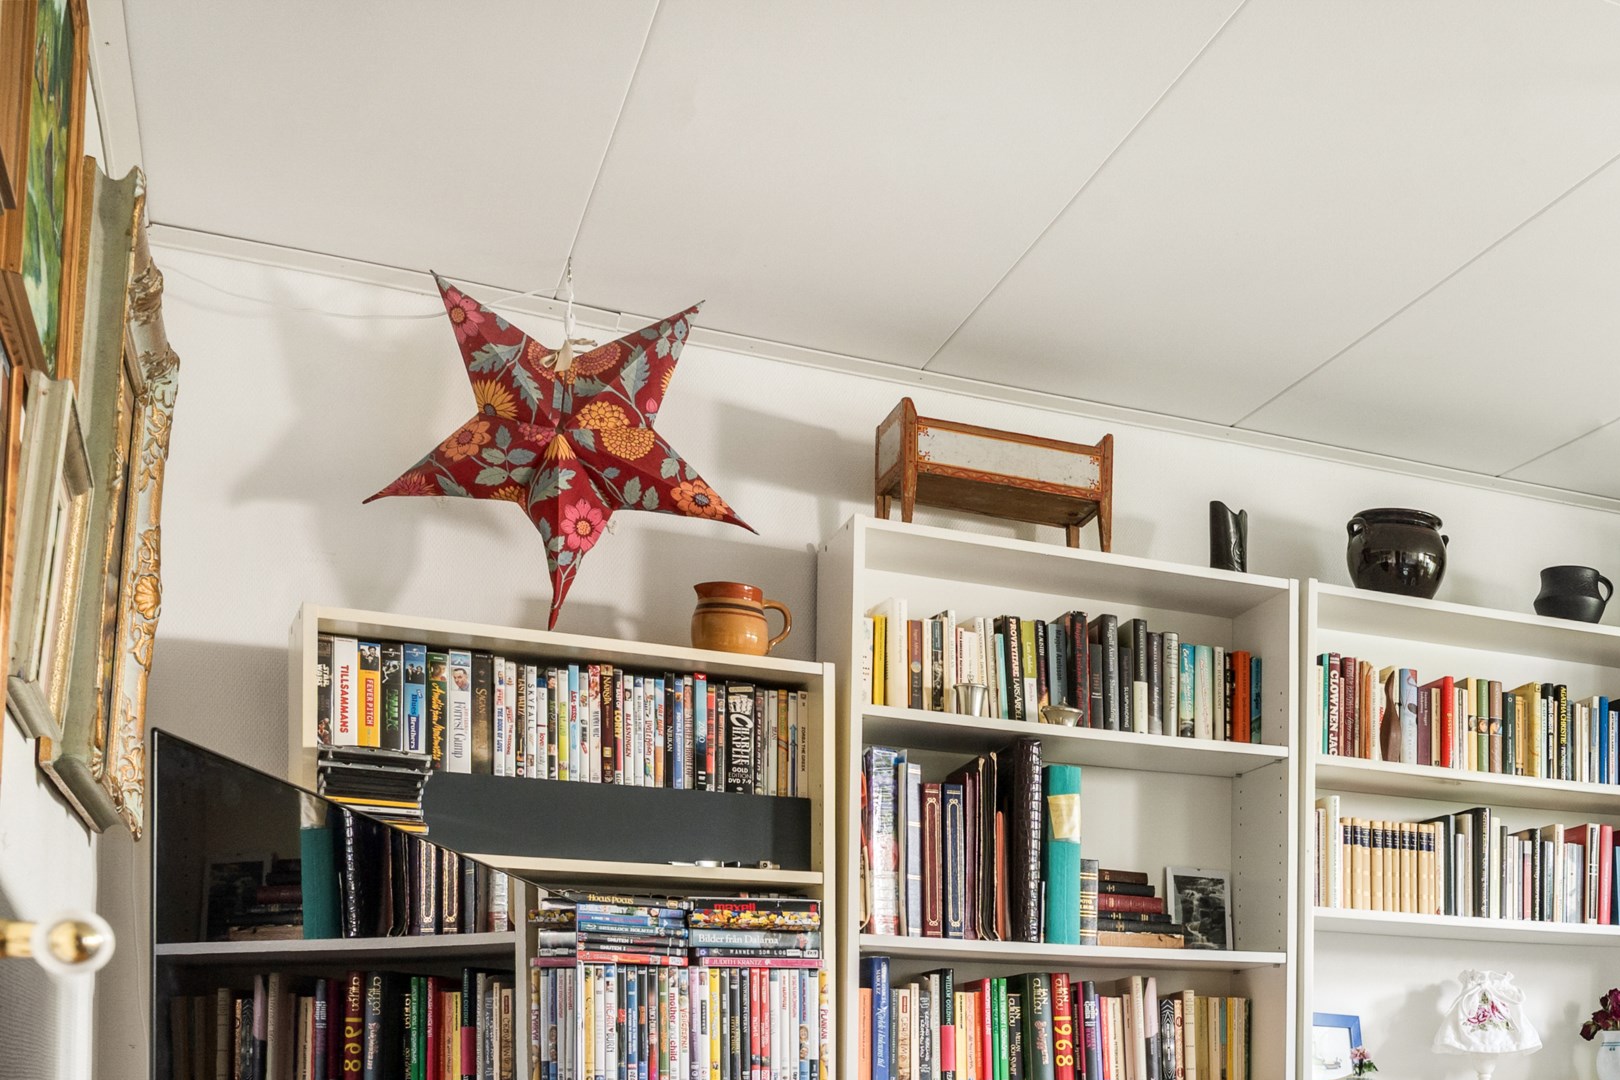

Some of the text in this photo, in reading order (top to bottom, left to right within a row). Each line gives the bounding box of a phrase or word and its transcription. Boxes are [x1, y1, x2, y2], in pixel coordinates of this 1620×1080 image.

[1055, 629, 1063, 680] Majgull Axelsson
[1107, 622, 1117, 723] Majgull Axelsson Slumpvandring
[340, 665, 349, 733] TILLSAMMANS
[603, 676, 612, 704] NARNIA
[1329, 670, 1339, 732] CLOWNEN
[410, 716, 418, 749] Brothers
[453, 701, 466, 759] Forrest Gump
[614, 710, 622, 739] LORRY
[587, 894, 634, 905] HOCUS POCUS
[713, 903, 756, 911] maxell
[698, 933, 779, 945] Bilder från Dalarna
[669, 993, 677, 1024] mother
[1033, 978, 1043, 1014] GUILLOU
[1055, 978, 1065, 1011] GUILLOU
[820, 1009, 829, 1039] PLANKAN
[1008, 998, 1016, 1027] GUILLOU
[1054, 1015, 1073, 1067] 1968
[1009, 1056, 1017, 1076] SVART
